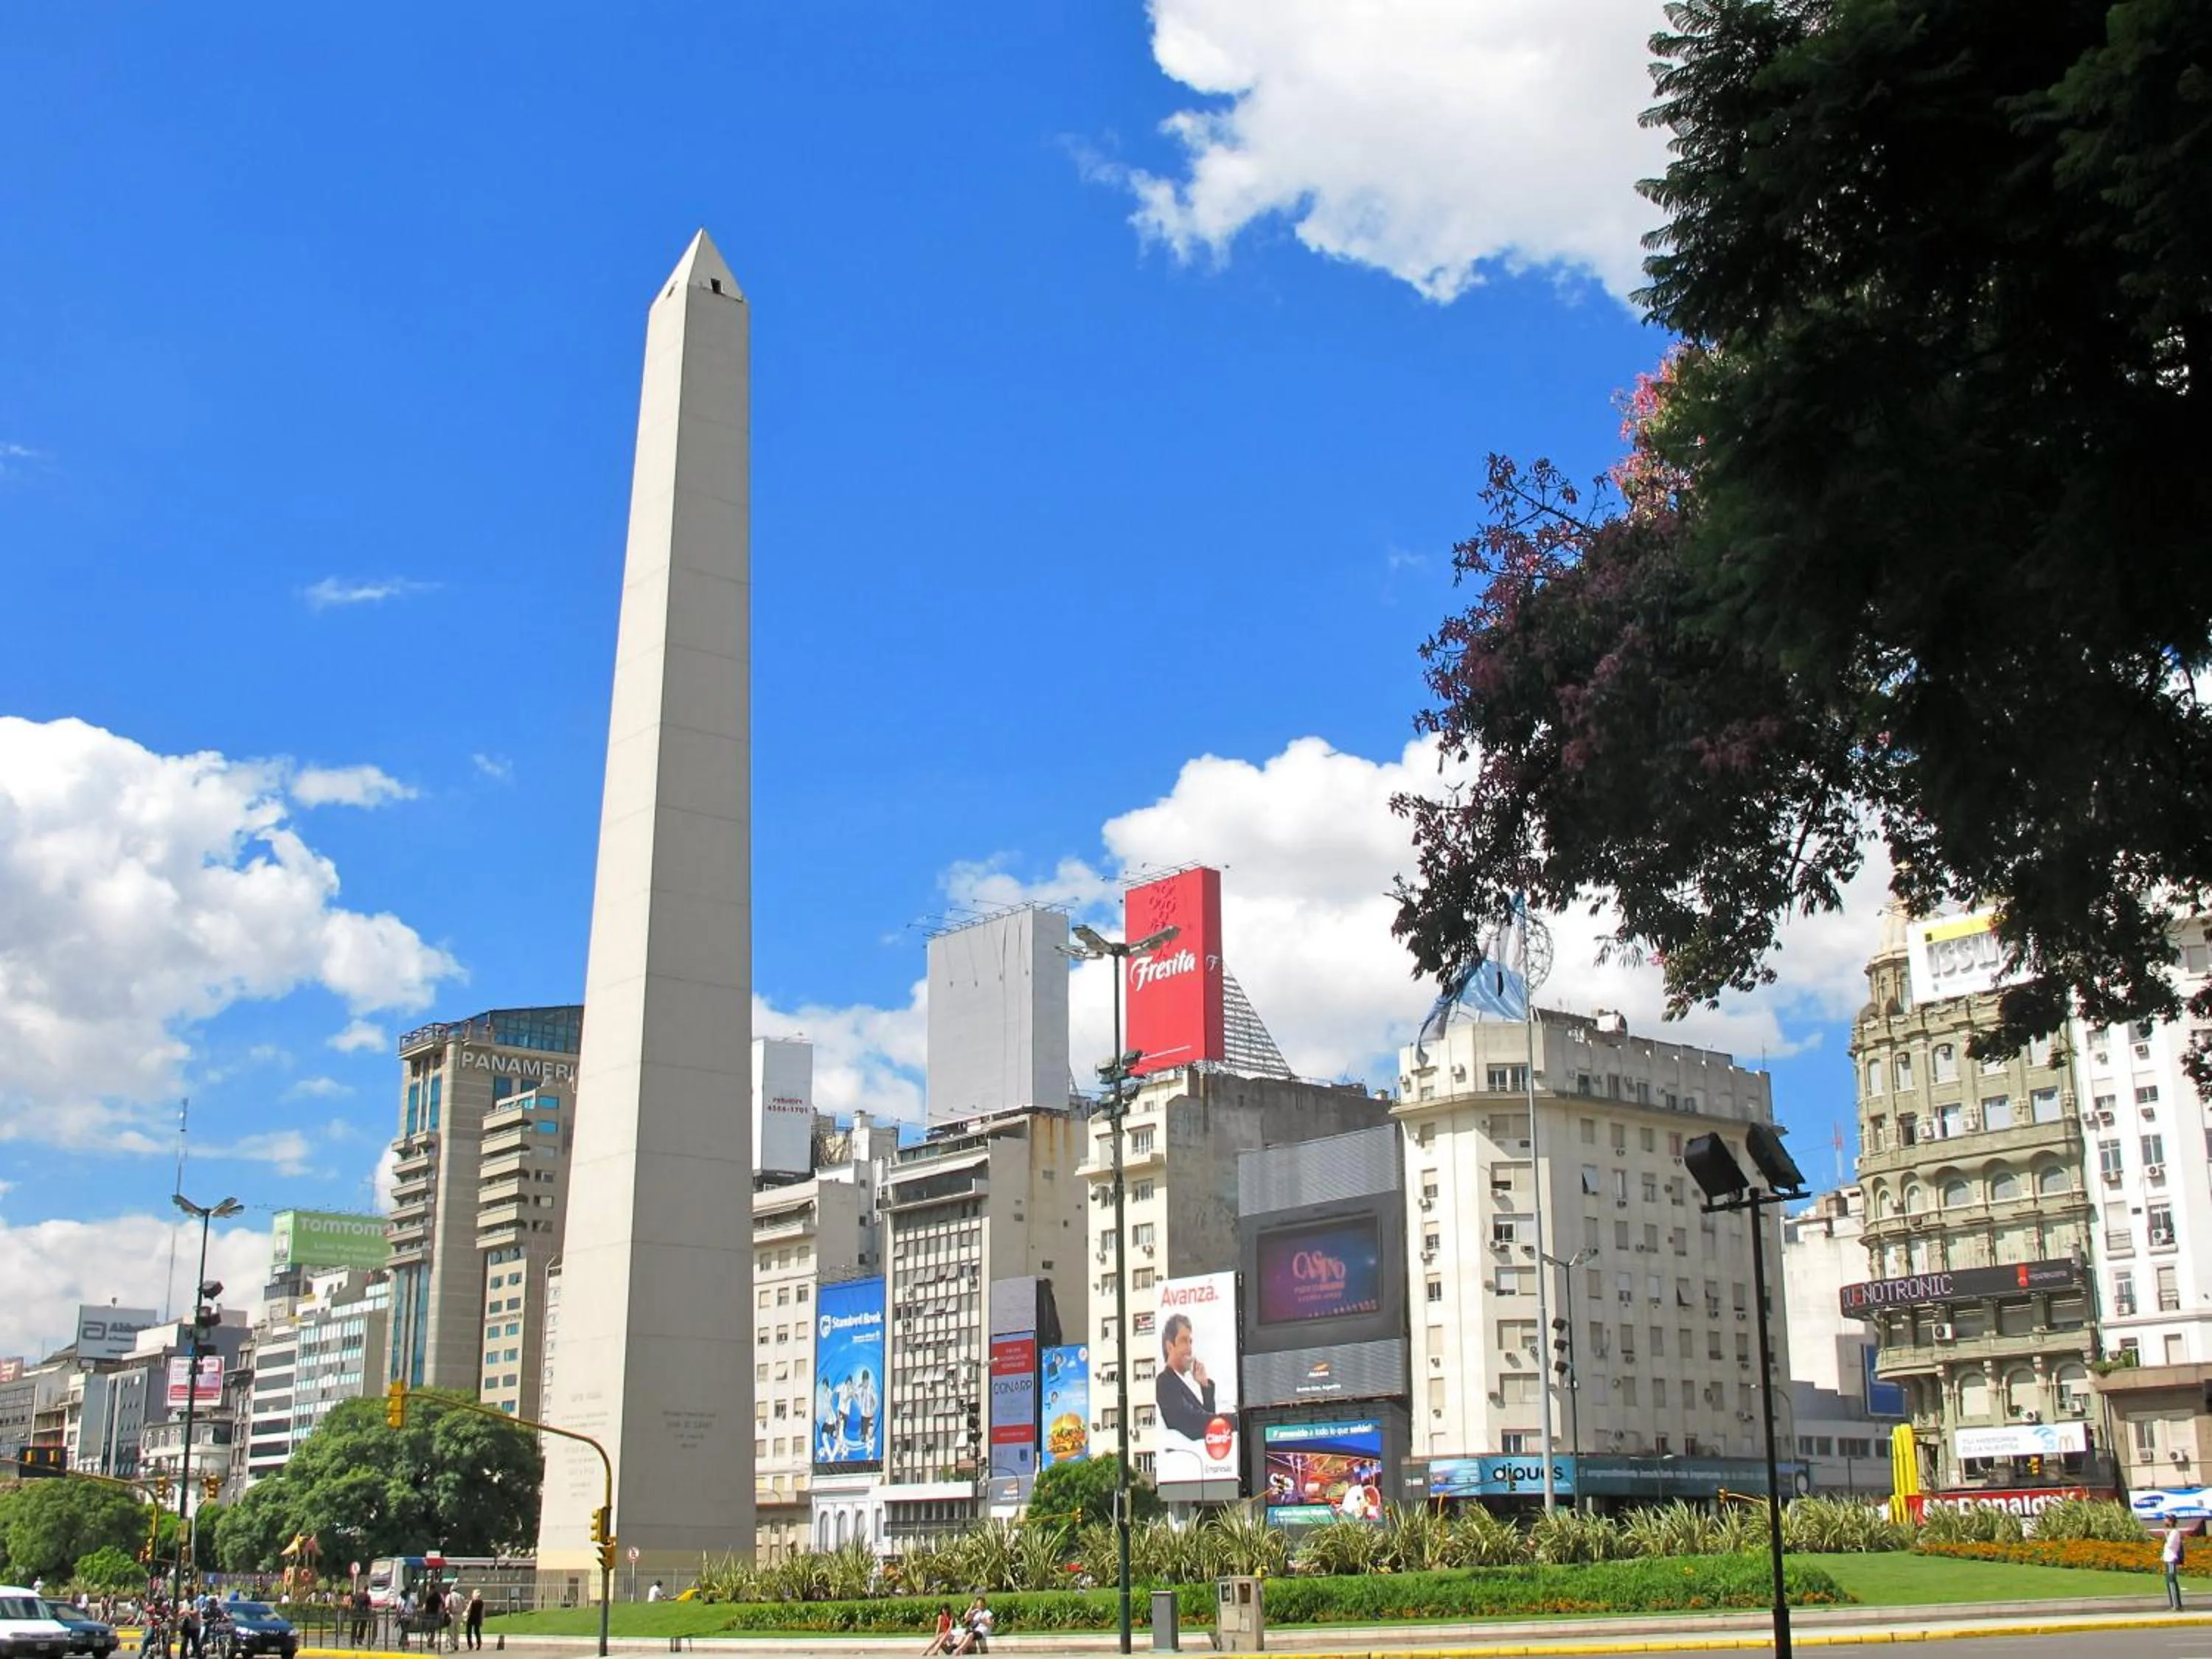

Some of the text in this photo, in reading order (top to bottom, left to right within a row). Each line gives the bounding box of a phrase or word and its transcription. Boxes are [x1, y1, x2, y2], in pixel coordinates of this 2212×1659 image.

[1130, 948, 1196, 992] Fresita
[863, 1310, 881, 1325] Bank
[1492, 1462, 1565, 1481] diqus
